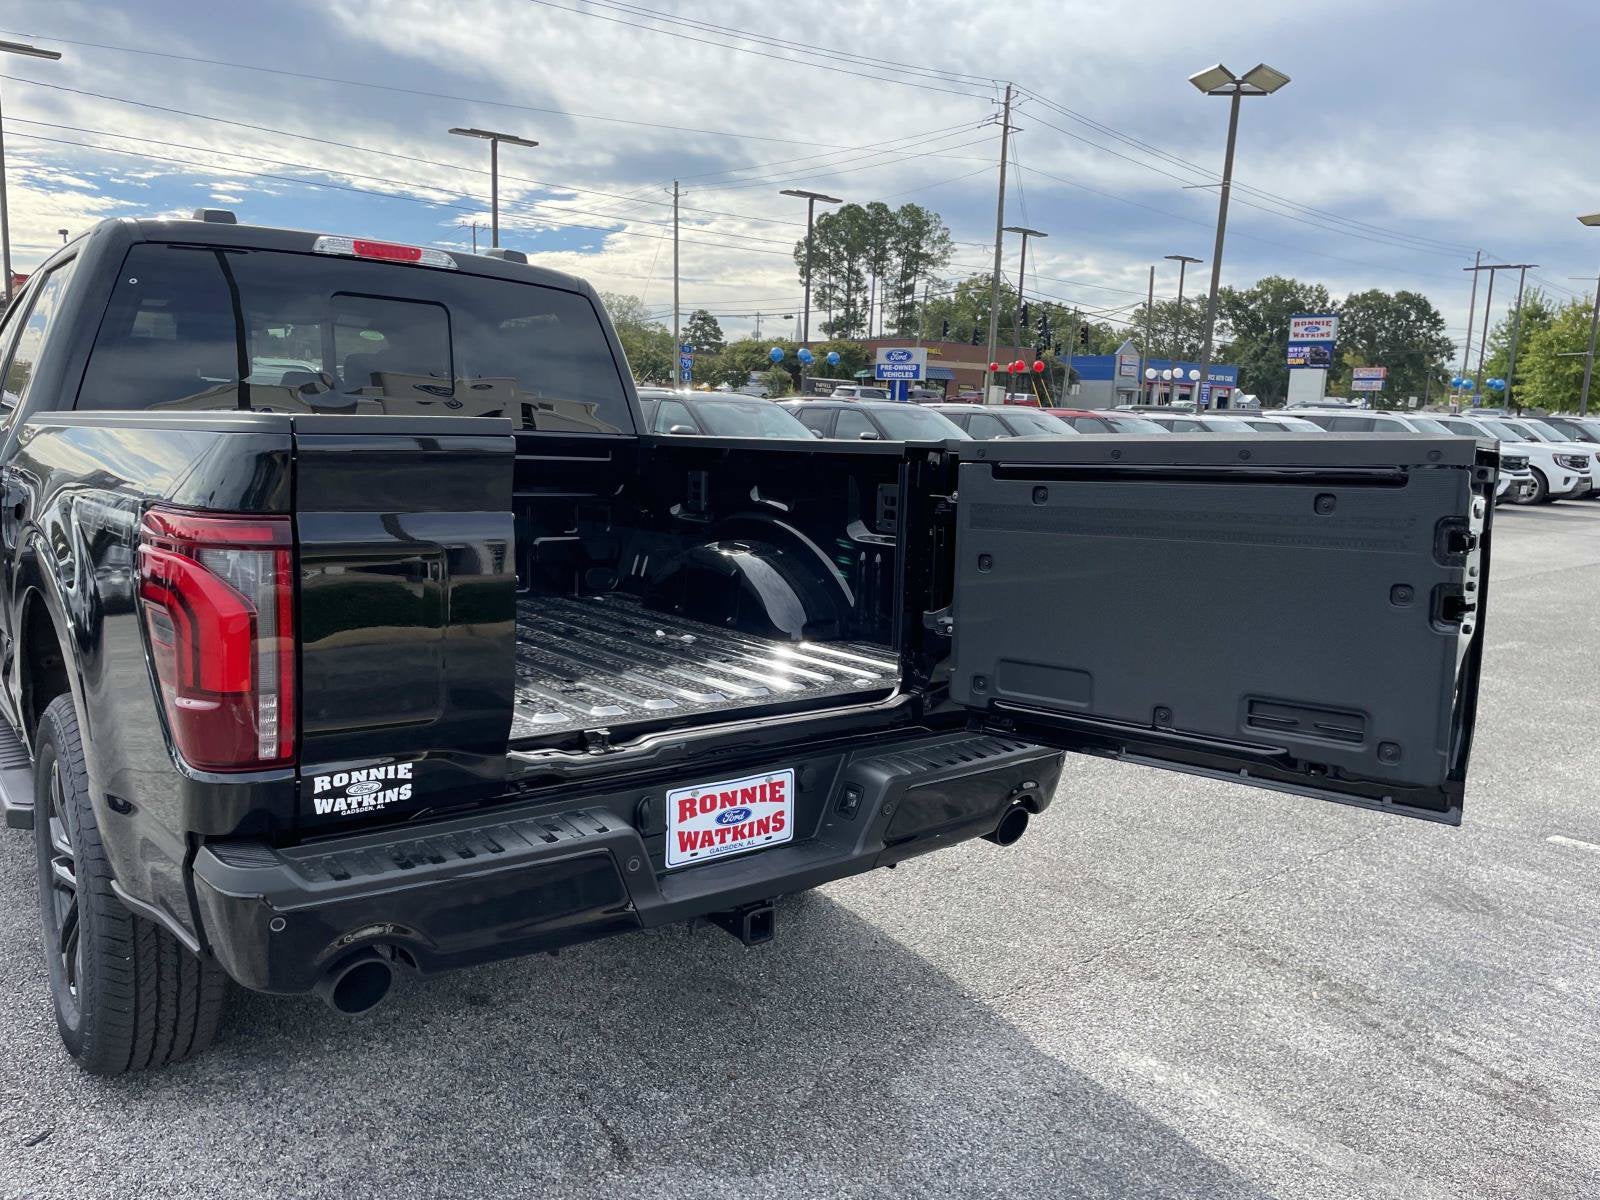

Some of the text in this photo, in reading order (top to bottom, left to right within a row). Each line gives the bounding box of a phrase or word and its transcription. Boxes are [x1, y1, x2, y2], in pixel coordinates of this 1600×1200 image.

[888, 351, 909, 361] Ford
[313, 762, 413, 794] RONNIE
[313, 783, 412, 815] WATKINS
[678, 780, 785, 823] RONNIE
[677, 810, 785, 853] WATKINS
[720, 809, 748, 824] Ford
